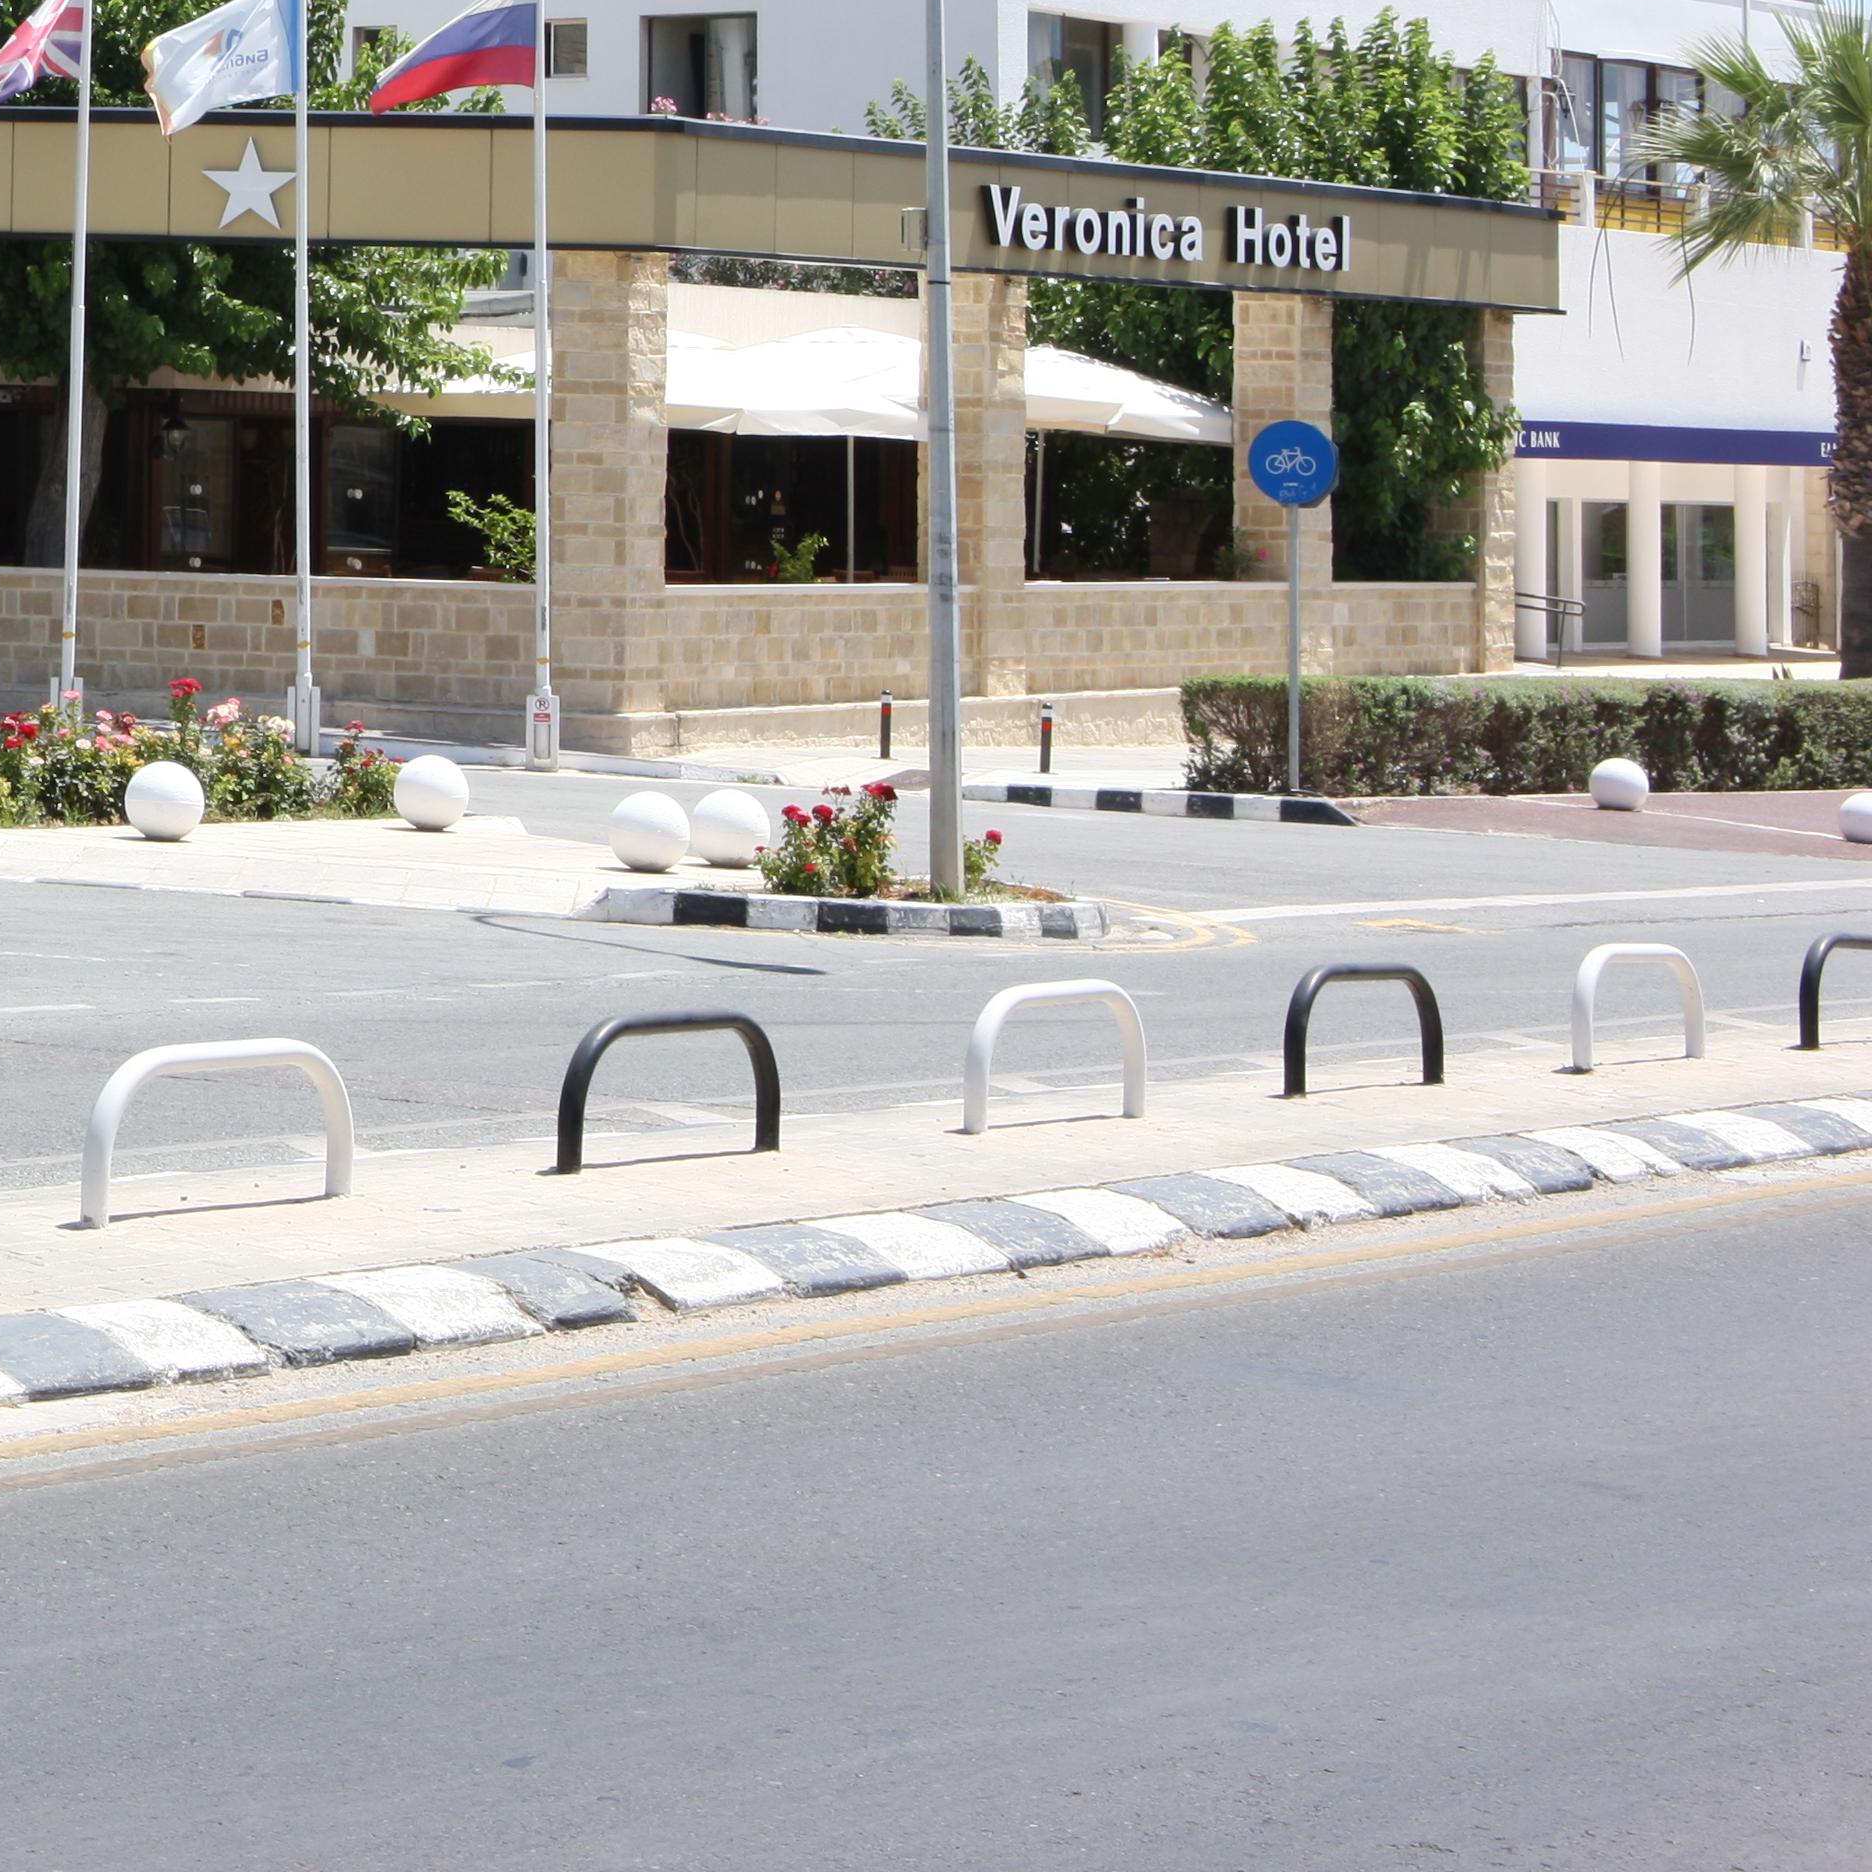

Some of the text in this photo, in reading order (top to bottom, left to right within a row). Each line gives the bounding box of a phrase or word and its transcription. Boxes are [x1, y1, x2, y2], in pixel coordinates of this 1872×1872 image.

[986, 183, 1351, 273] Veronica Hotel
[1530, 430, 1561, 449] BANK
